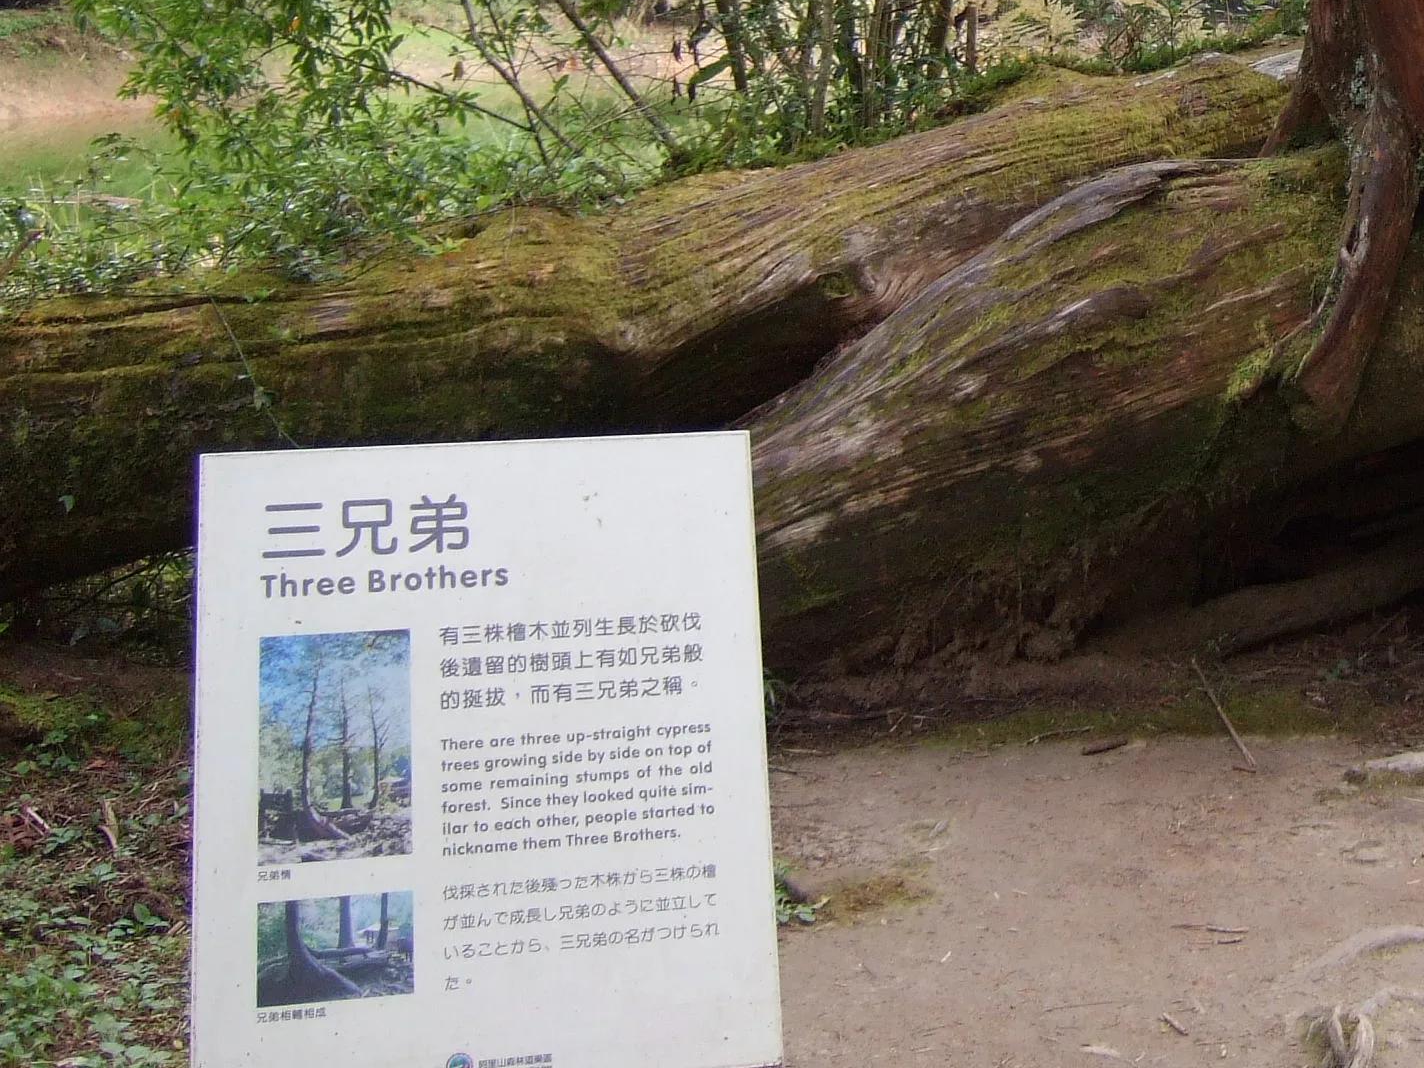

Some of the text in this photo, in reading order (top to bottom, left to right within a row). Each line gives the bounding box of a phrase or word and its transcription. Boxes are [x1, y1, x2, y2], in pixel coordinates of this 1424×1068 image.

[262, 493, 470, 559] 三兄弟
[260, 565, 509, 599] Three Brothers
[439, 611, 702, 646] 有三株檜木並列生長於砍伐
[439, 643, 704, 678] 後遺留的樹頭上有如兄弟般
[440, 723, 711, 751] There are three up-straight cypress
[441, 740, 712, 772] trees growing side by side on top of
[441, 761, 713, 793] some remaining stumps of the old
[440, 782, 713, 814] forest. Since they looked quite sim-
[442, 803, 715, 835] ilar to each other, people started to
[442, 827, 681, 856] nickname them Three Brothers.
